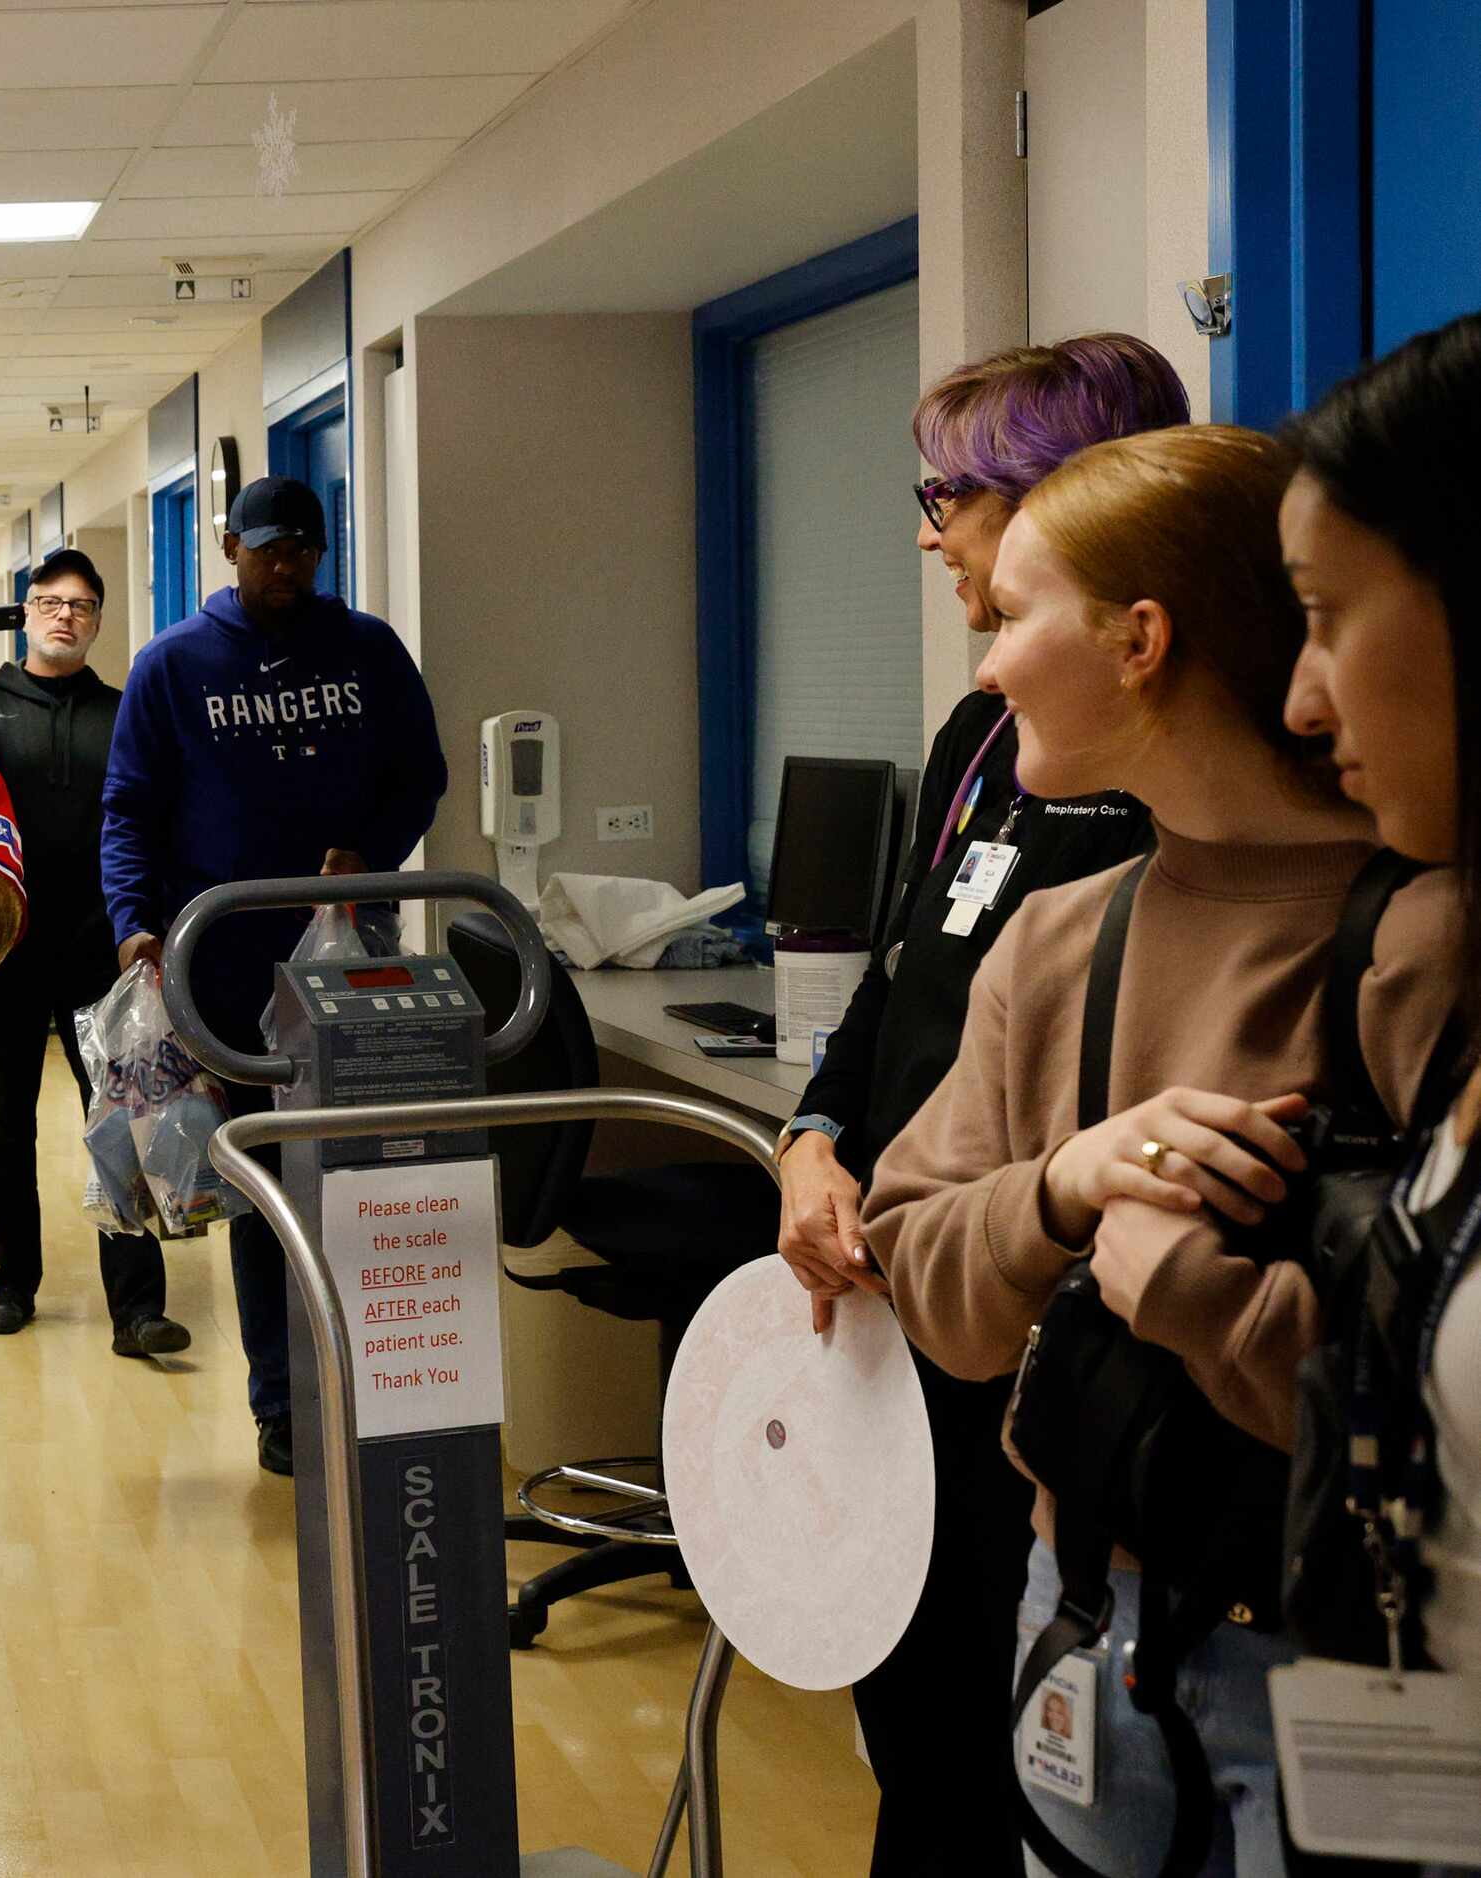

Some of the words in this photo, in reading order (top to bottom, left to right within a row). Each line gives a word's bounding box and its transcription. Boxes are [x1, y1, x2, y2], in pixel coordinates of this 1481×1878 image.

[205, 682, 362, 729] RANGERS
[271, 745, 286, 761] T
[1045, 804, 1097, 816] Respiratory
[1100, 805, 1128, 816] Care
[359, 1200, 411, 1217] Please
[416, 1196, 459, 1213] clean
[373, 1232, 401, 1250] the
[406, 1229, 447, 1248] scale
[361, 1265, 427, 1286] BEFORE
[431, 1260, 462, 1280] and
[365, 1299, 417, 1320] AFTER
[422, 1294, 461, 1314] each
[365, 1333, 425, 1357] patient
[430, 1331, 463, 1348] use.
[372, 1369, 424, 1390] Thank
[427, 1368, 459, 1385] You
[404, 1465, 439, 1624] SCALE
[410, 1644, 448, 1837] TRONIX
